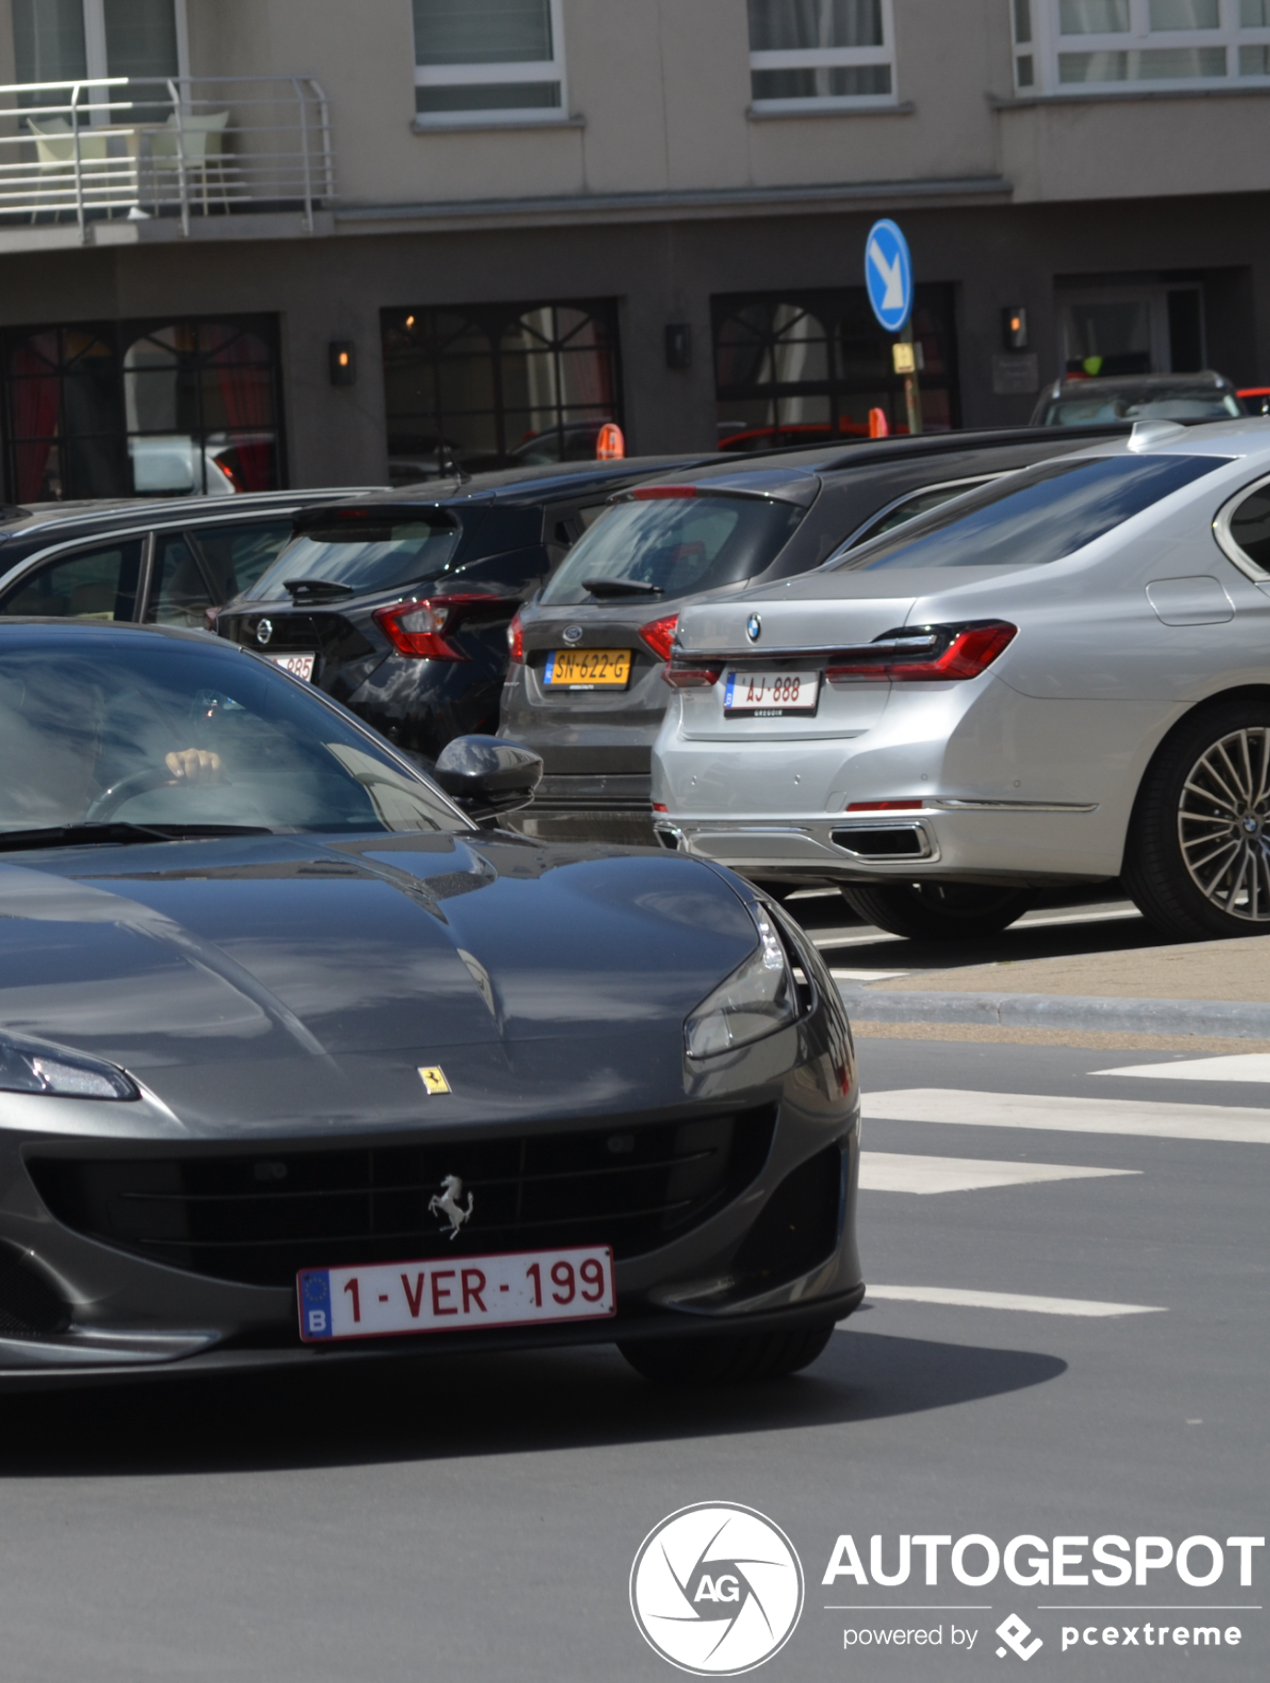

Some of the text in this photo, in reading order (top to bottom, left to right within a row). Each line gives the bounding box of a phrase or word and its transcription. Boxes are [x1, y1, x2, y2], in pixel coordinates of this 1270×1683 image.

[556, 654, 625, 678] SN-622-G
[309, 1258, 606, 1332] B 1-VER-199
